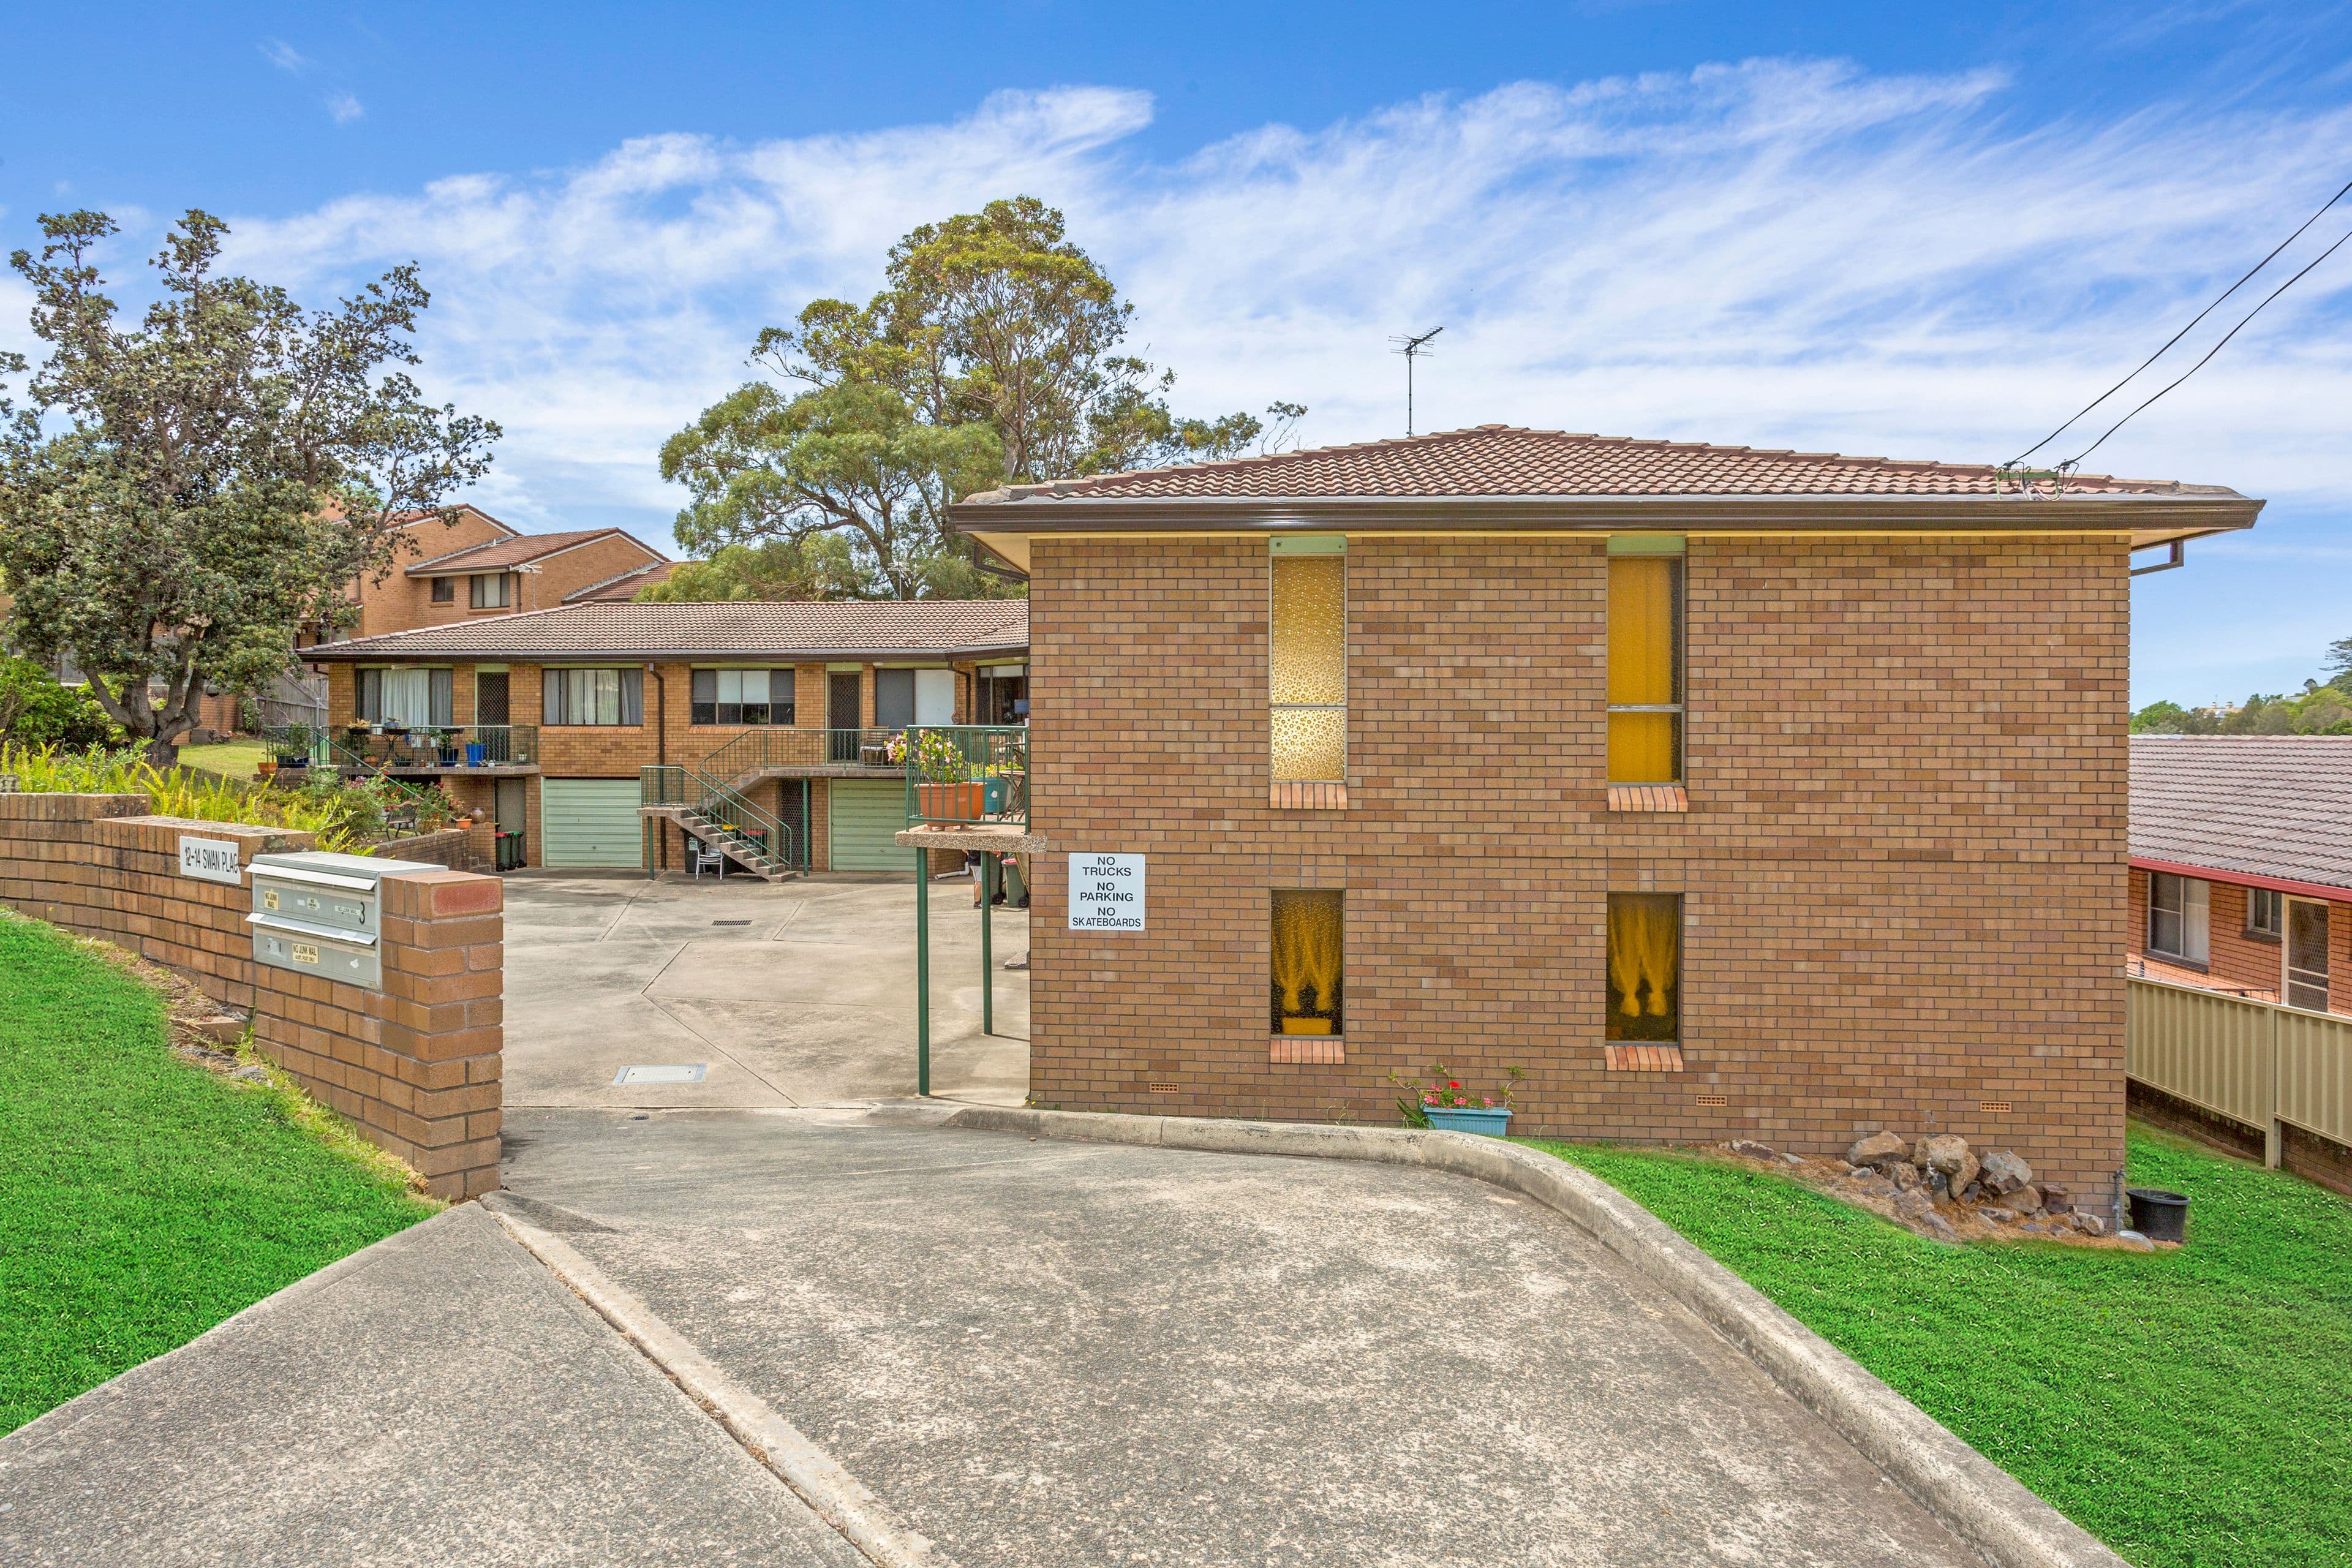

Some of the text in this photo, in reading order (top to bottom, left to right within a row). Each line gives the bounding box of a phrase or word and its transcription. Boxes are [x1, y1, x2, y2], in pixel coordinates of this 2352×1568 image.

[185, 846, 201, 867] 12-14
[203, 848, 220, 871] SWAN
[1098, 856, 1115, 865] NO
[1082, 867, 1131, 876] TRUCKS
[1097, 882, 1115, 891] NO
[1080, 892, 1133, 902] PARKING
[359, 901, 365, 925] 3
[1098, 907, 1115, 916] NO
[1072, 917, 1141, 927] SKATEBOARDS
[293, 944, 299, 953] NO
[300, 945, 308, 954] JUNK
